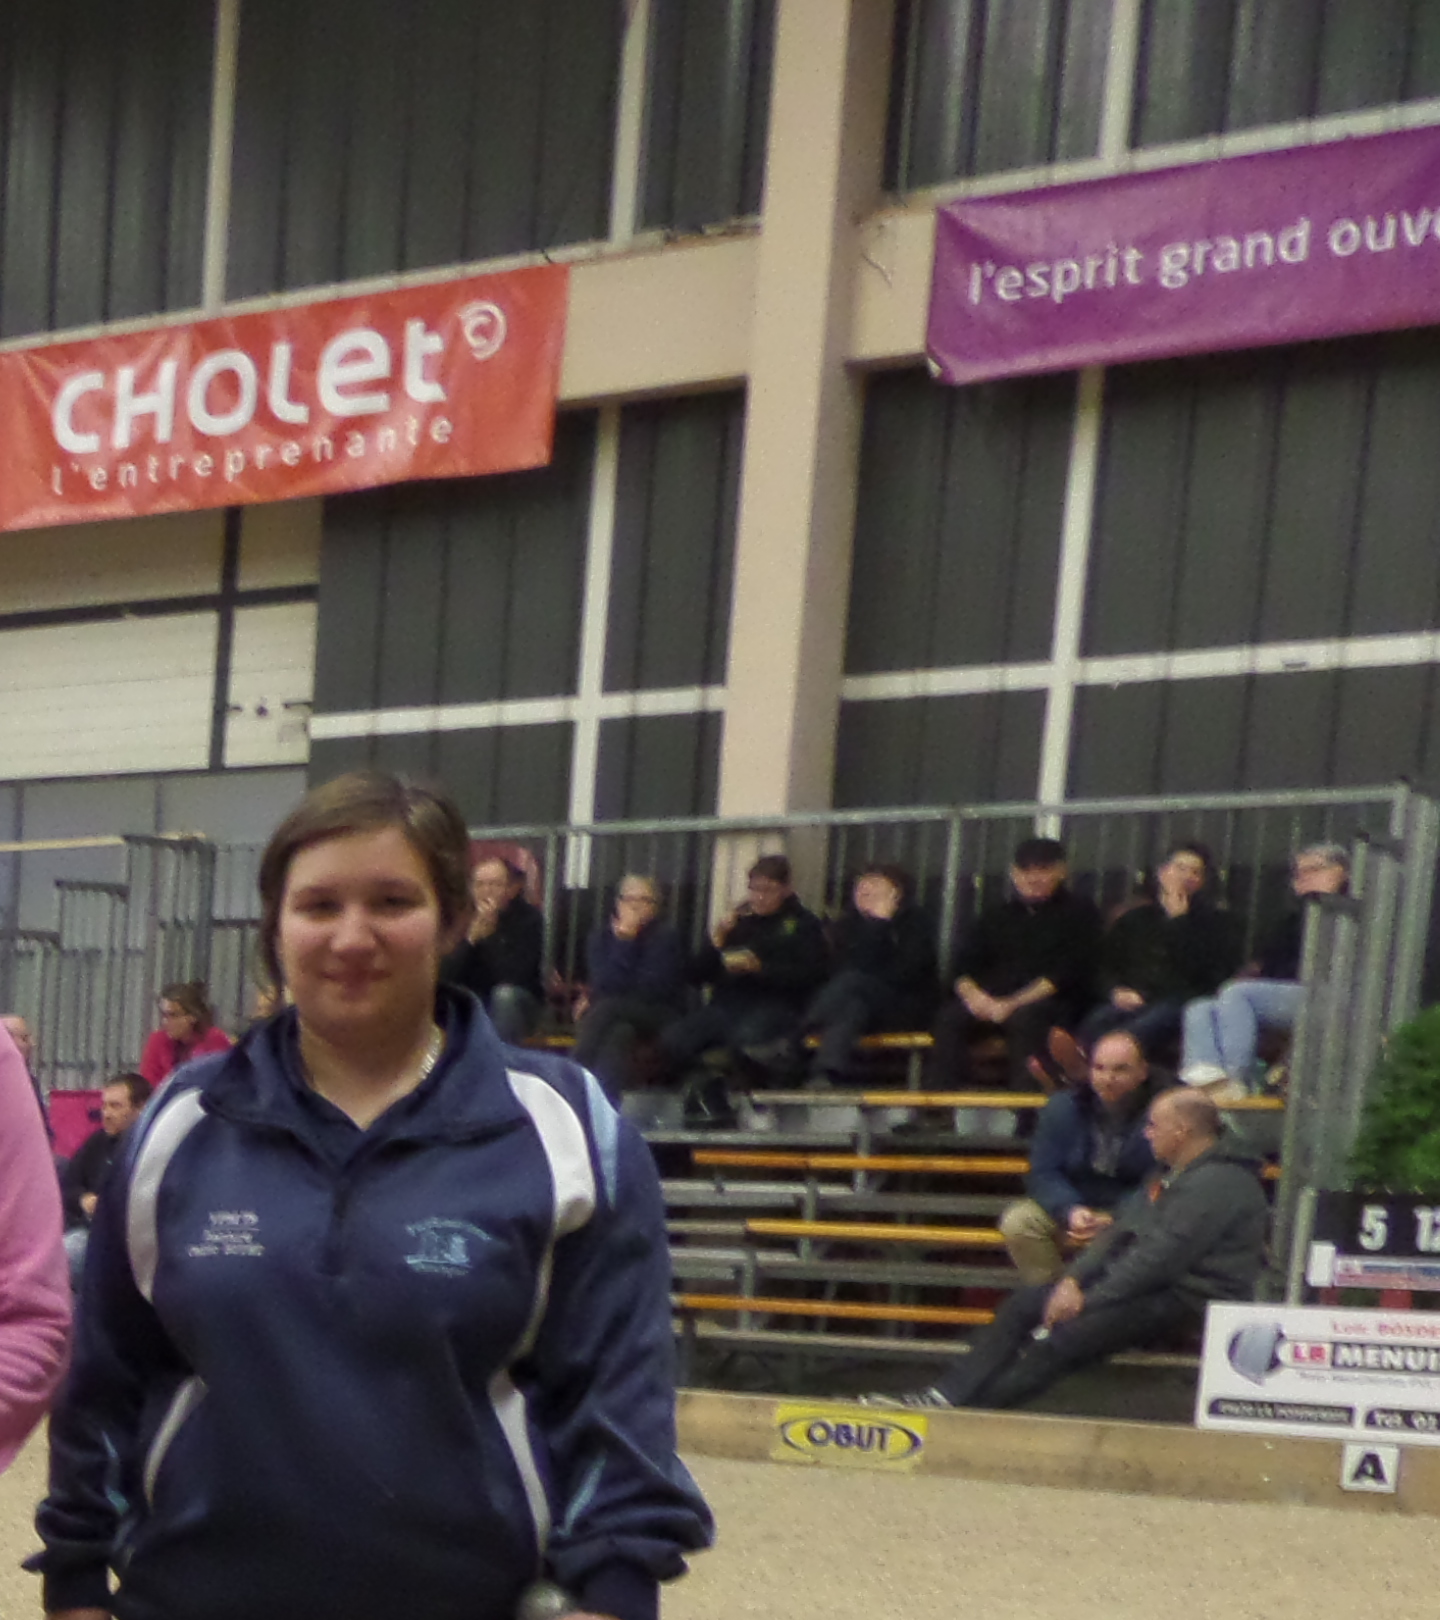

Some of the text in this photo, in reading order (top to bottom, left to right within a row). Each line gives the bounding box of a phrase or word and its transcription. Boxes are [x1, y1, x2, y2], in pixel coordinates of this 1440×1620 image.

[968, 240, 1144, 305] l'esprit
[1158, 216, 1311, 289] grand
[50, 414, 454, 496] l'entreprenante
[1358, 1204, 1389, 1251] 5
[807, 1419, 892, 1452] OBUT
[1351, 1451, 1388, 1484] A
